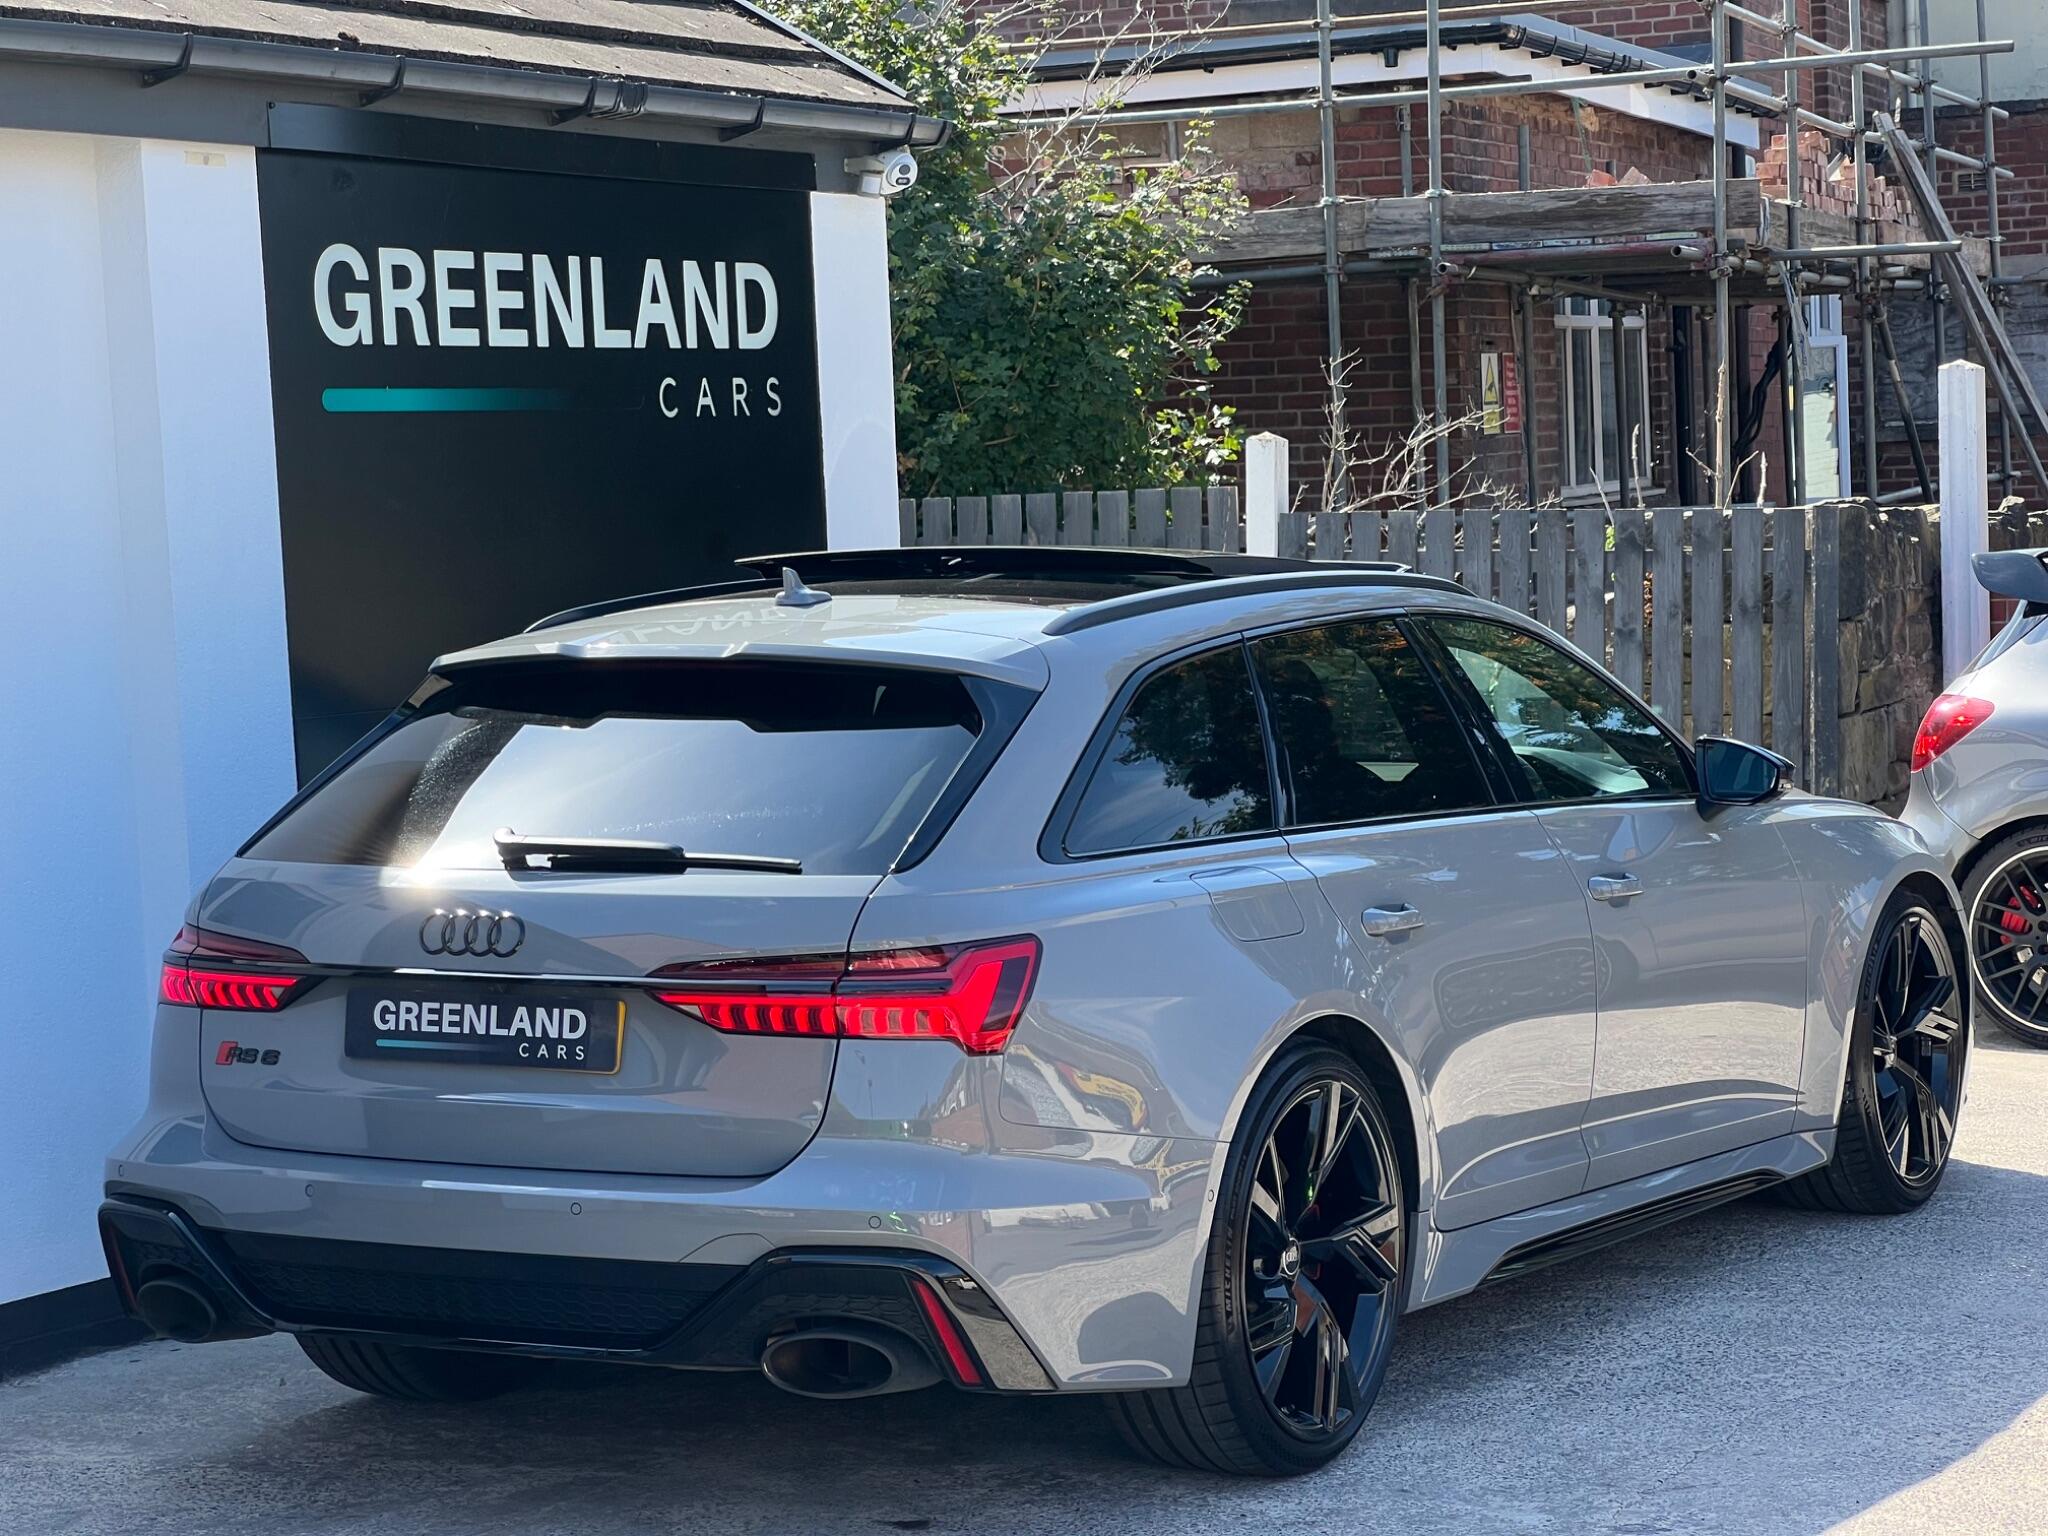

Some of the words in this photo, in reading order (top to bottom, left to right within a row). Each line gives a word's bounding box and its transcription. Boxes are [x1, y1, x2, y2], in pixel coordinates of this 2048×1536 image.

[314, 243, 779, 350] GREENLAND
[659, 377, 782, 418] CARS
[374, 1000, 587, 1039] GREENLAND
[519, 1043, 585, 1060] CARS
